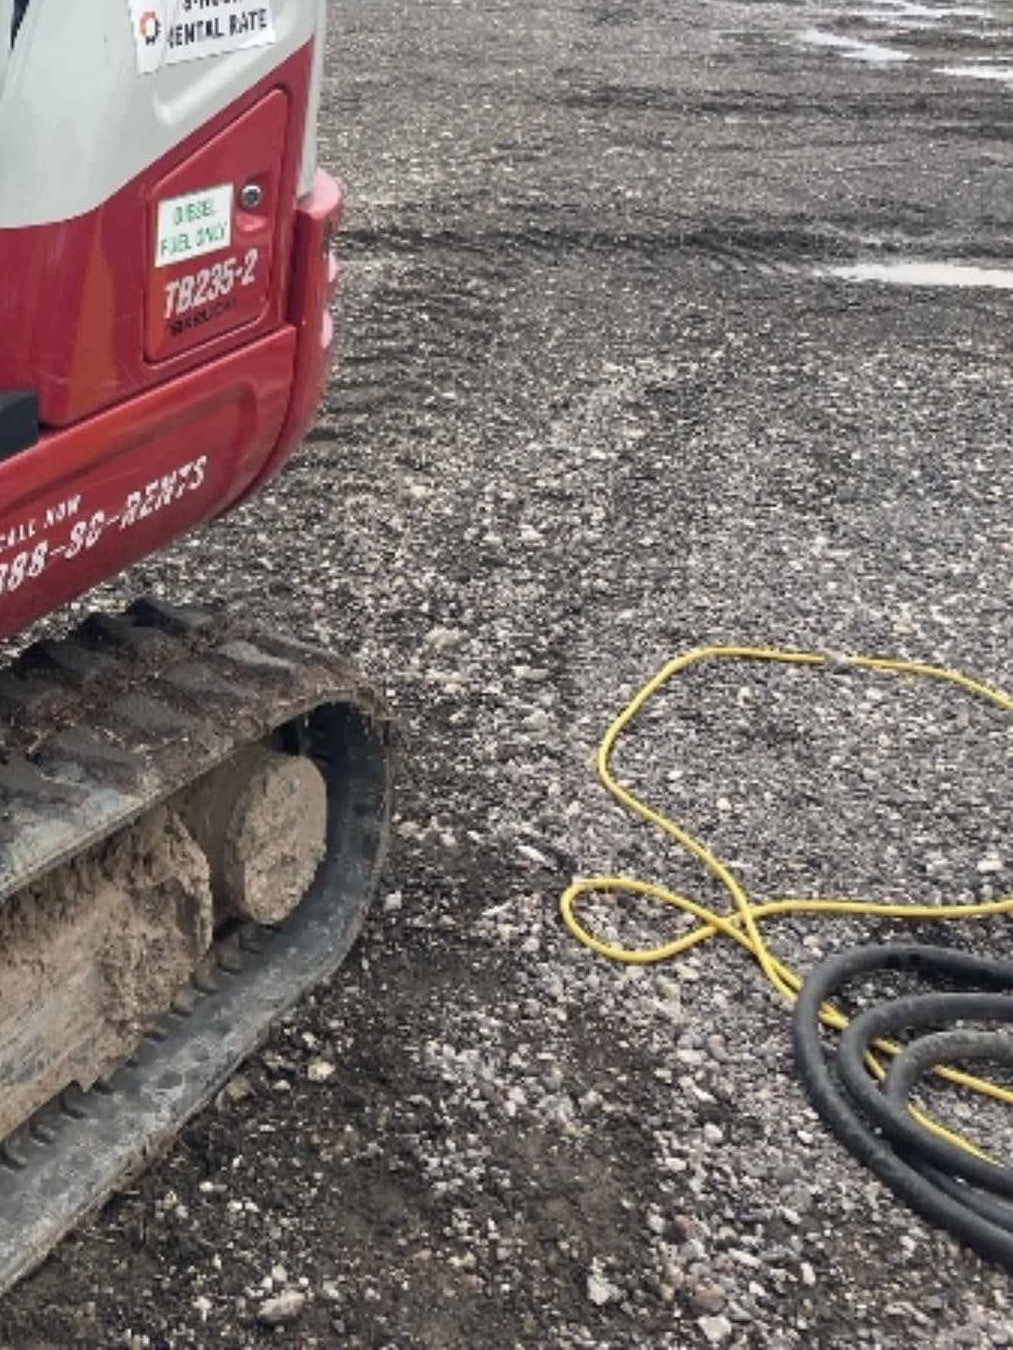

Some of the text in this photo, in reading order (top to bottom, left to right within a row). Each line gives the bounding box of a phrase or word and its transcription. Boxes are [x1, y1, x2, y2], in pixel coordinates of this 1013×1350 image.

[229, 8, 267, 37] RATE
[160, 221, 228, 257] FUEL ONLY
[164, 249, 258, 319] TB235-2
[43, 493, 82, 529] NOW
